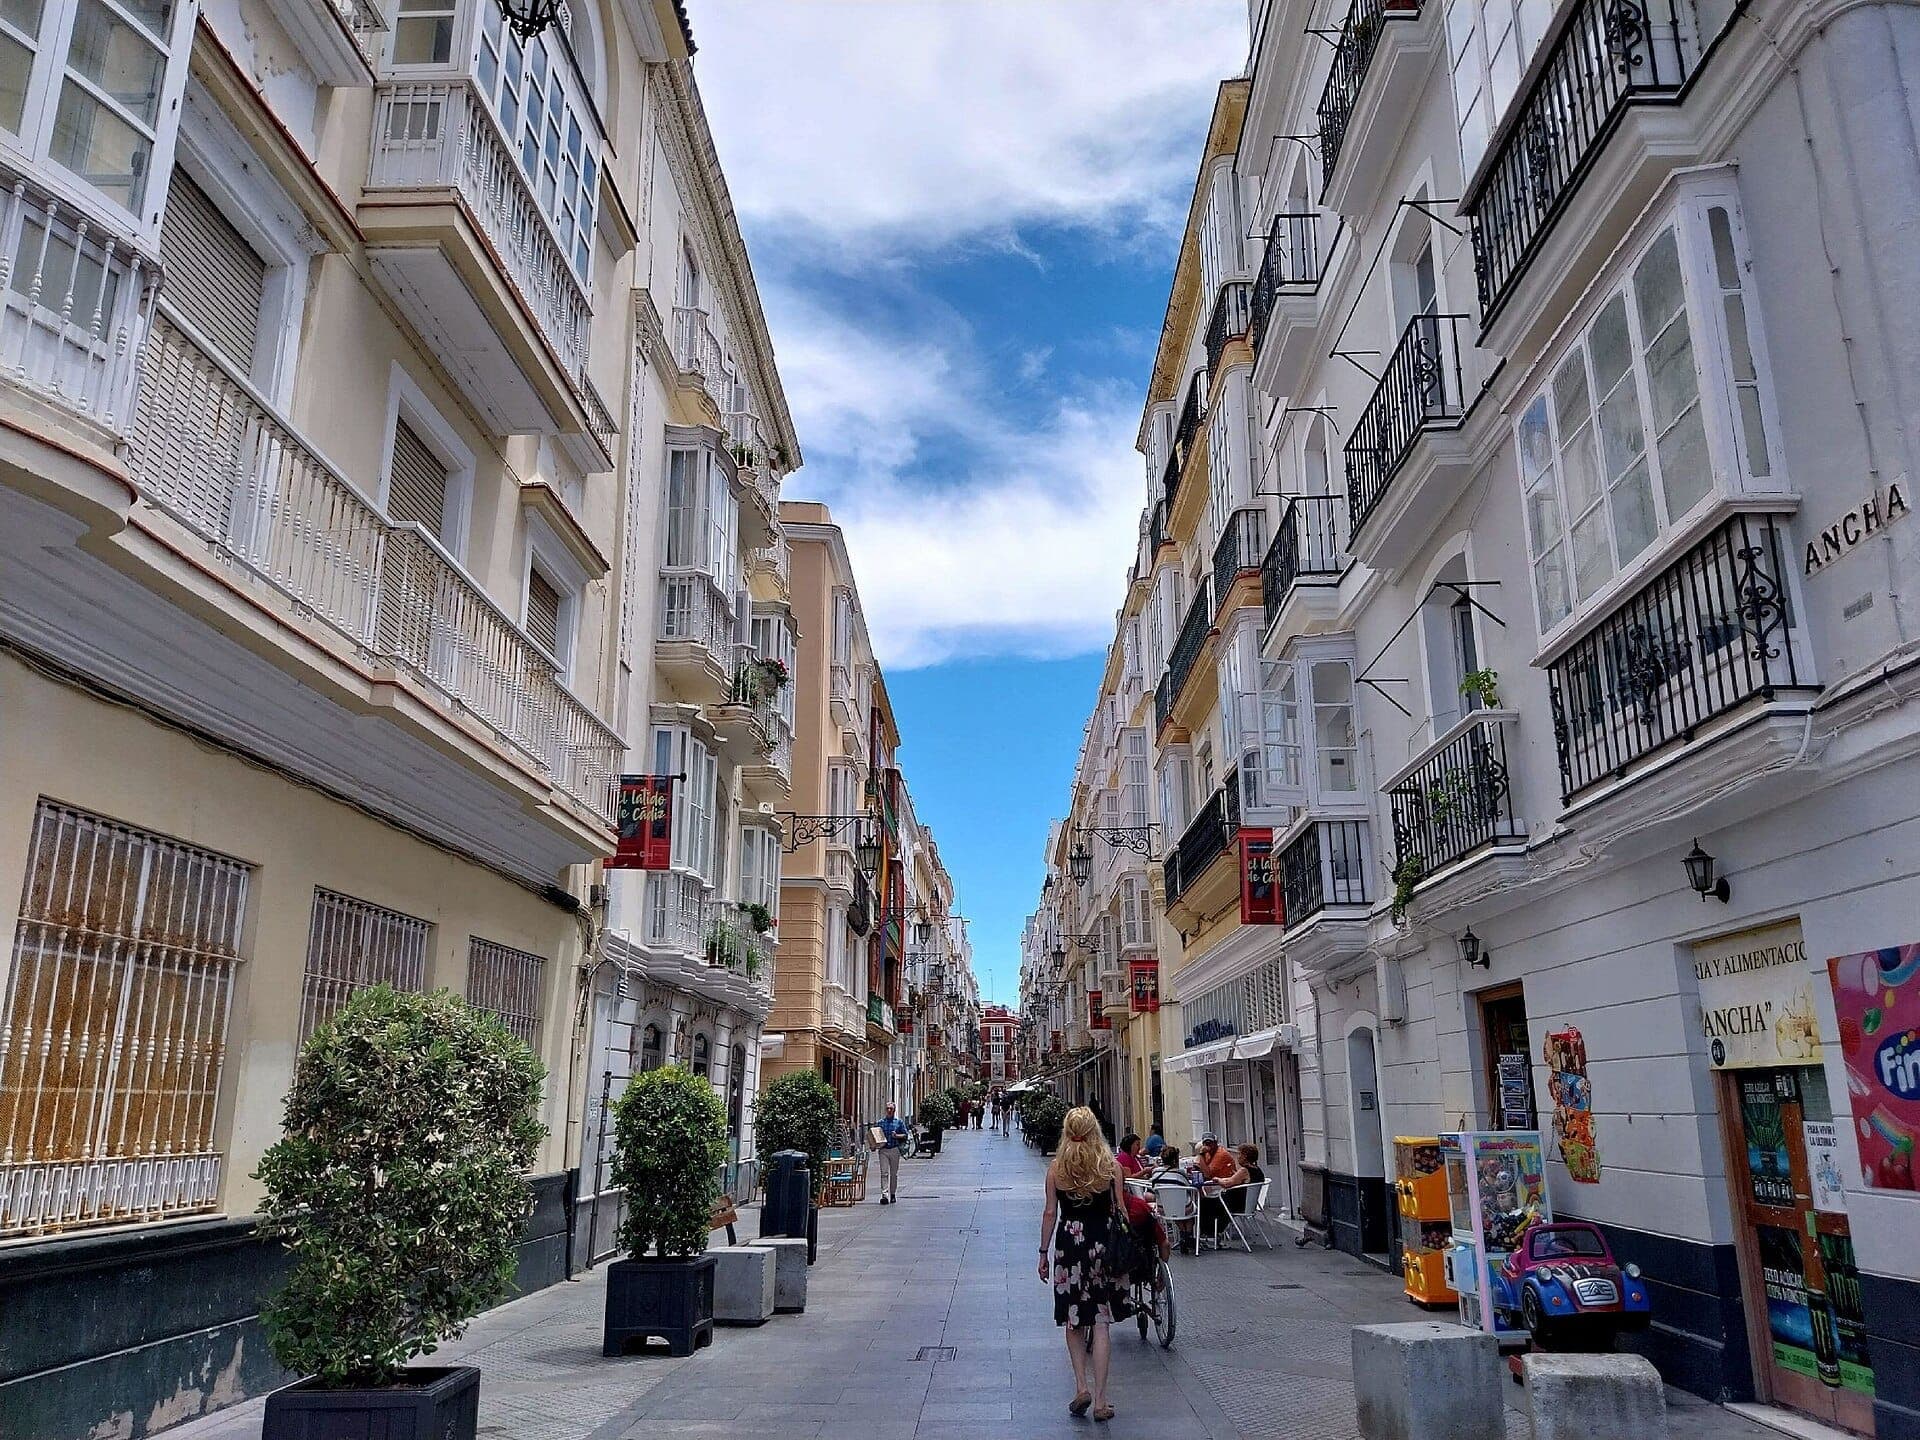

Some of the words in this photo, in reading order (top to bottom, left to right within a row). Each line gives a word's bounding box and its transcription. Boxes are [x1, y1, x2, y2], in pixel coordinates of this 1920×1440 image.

[1804, 483, 1906, 575] ANCHA
[631, 787, 666, 806] latido
[632, 806, 666, 821] Cádiz
[1713, 958, 1721, 977] Y
[1763, 1267, 1779, 1283] ZERO
